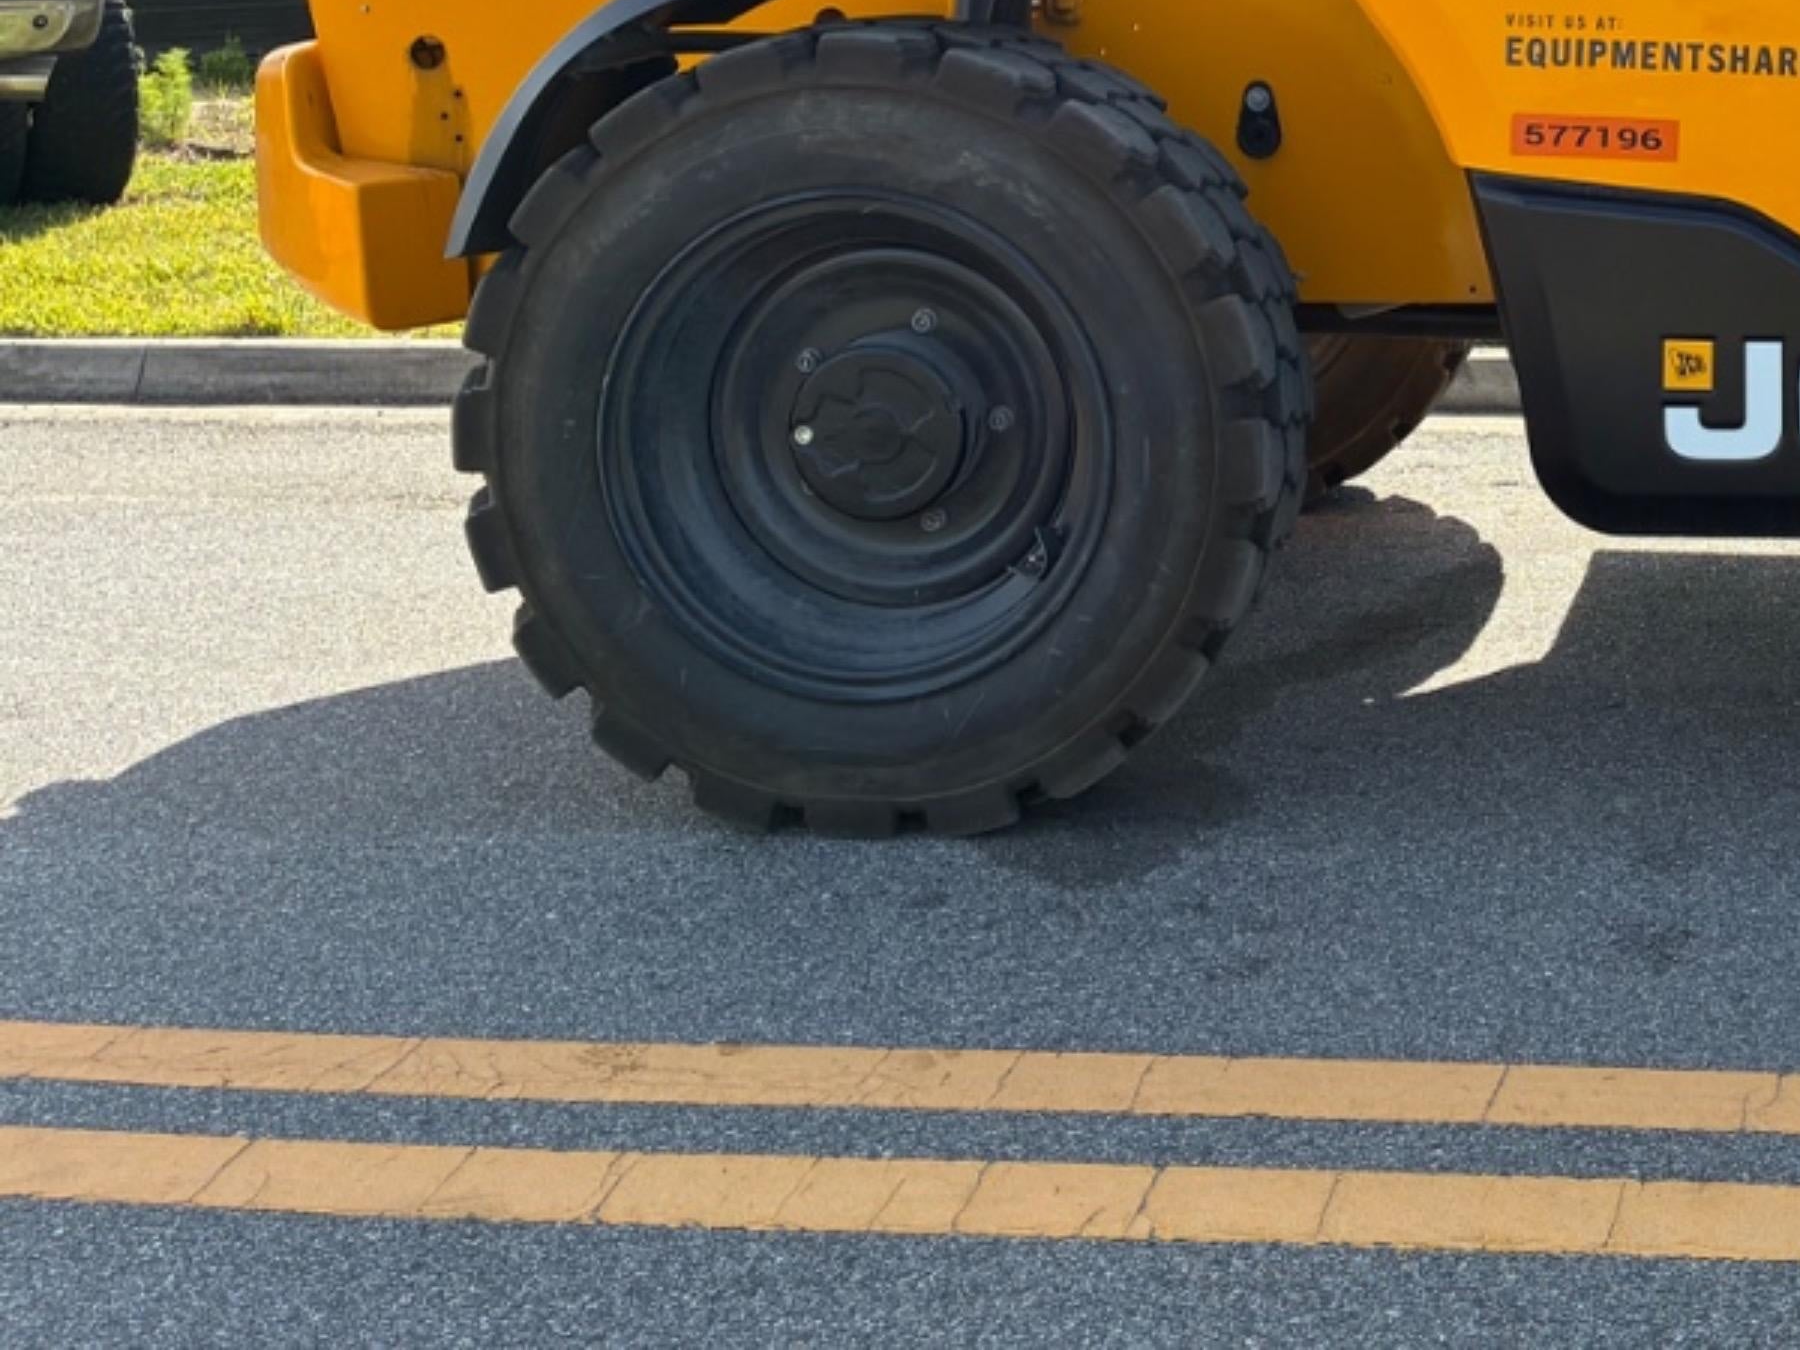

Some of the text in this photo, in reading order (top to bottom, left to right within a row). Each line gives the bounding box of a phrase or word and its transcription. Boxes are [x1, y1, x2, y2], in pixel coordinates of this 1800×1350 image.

[1505, 13, 1554, 29] VISIT
[1564, 14, 1587, 30] US
[1524, 122, 1664, 151] 577196
